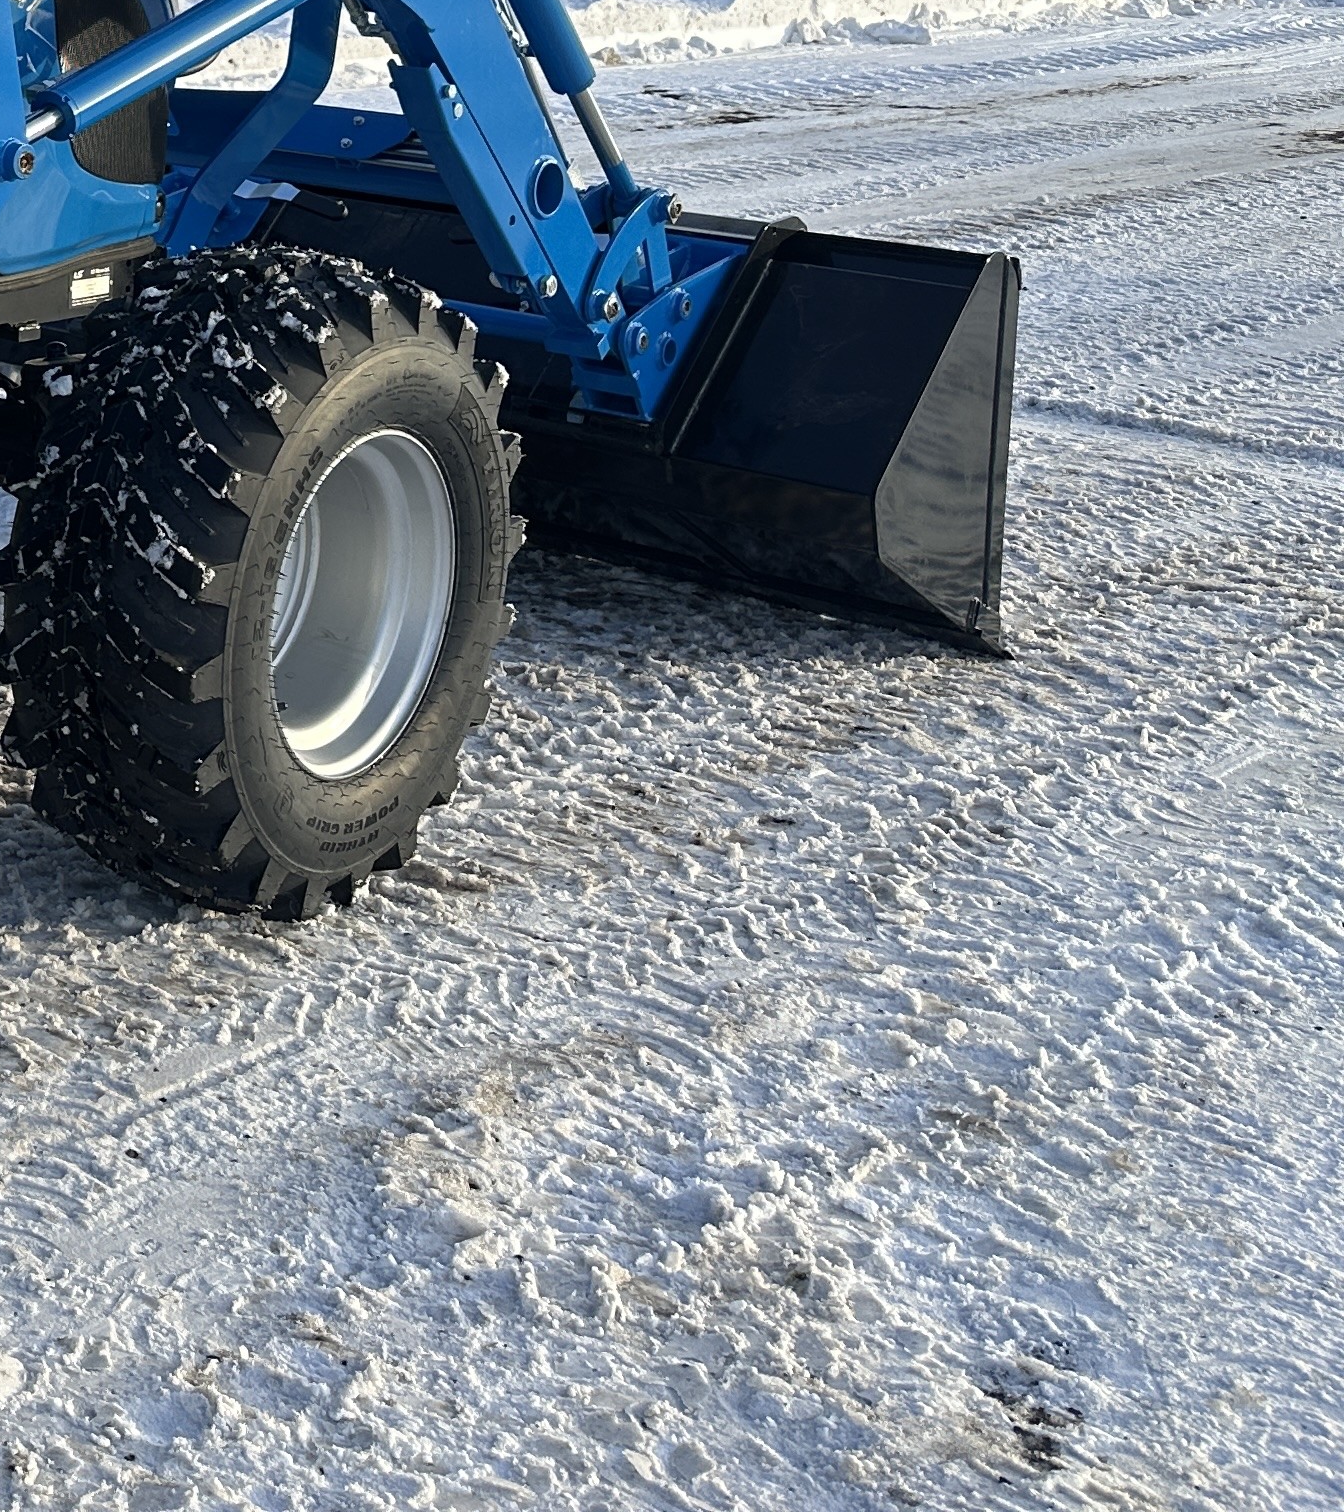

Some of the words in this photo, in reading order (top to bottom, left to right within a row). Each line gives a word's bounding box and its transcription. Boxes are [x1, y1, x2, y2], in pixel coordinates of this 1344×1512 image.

[306, 816, 340, 835] GRIP
[343, 795, 399, 835] POWER
[319, 829, 379, 853] HYBRID
